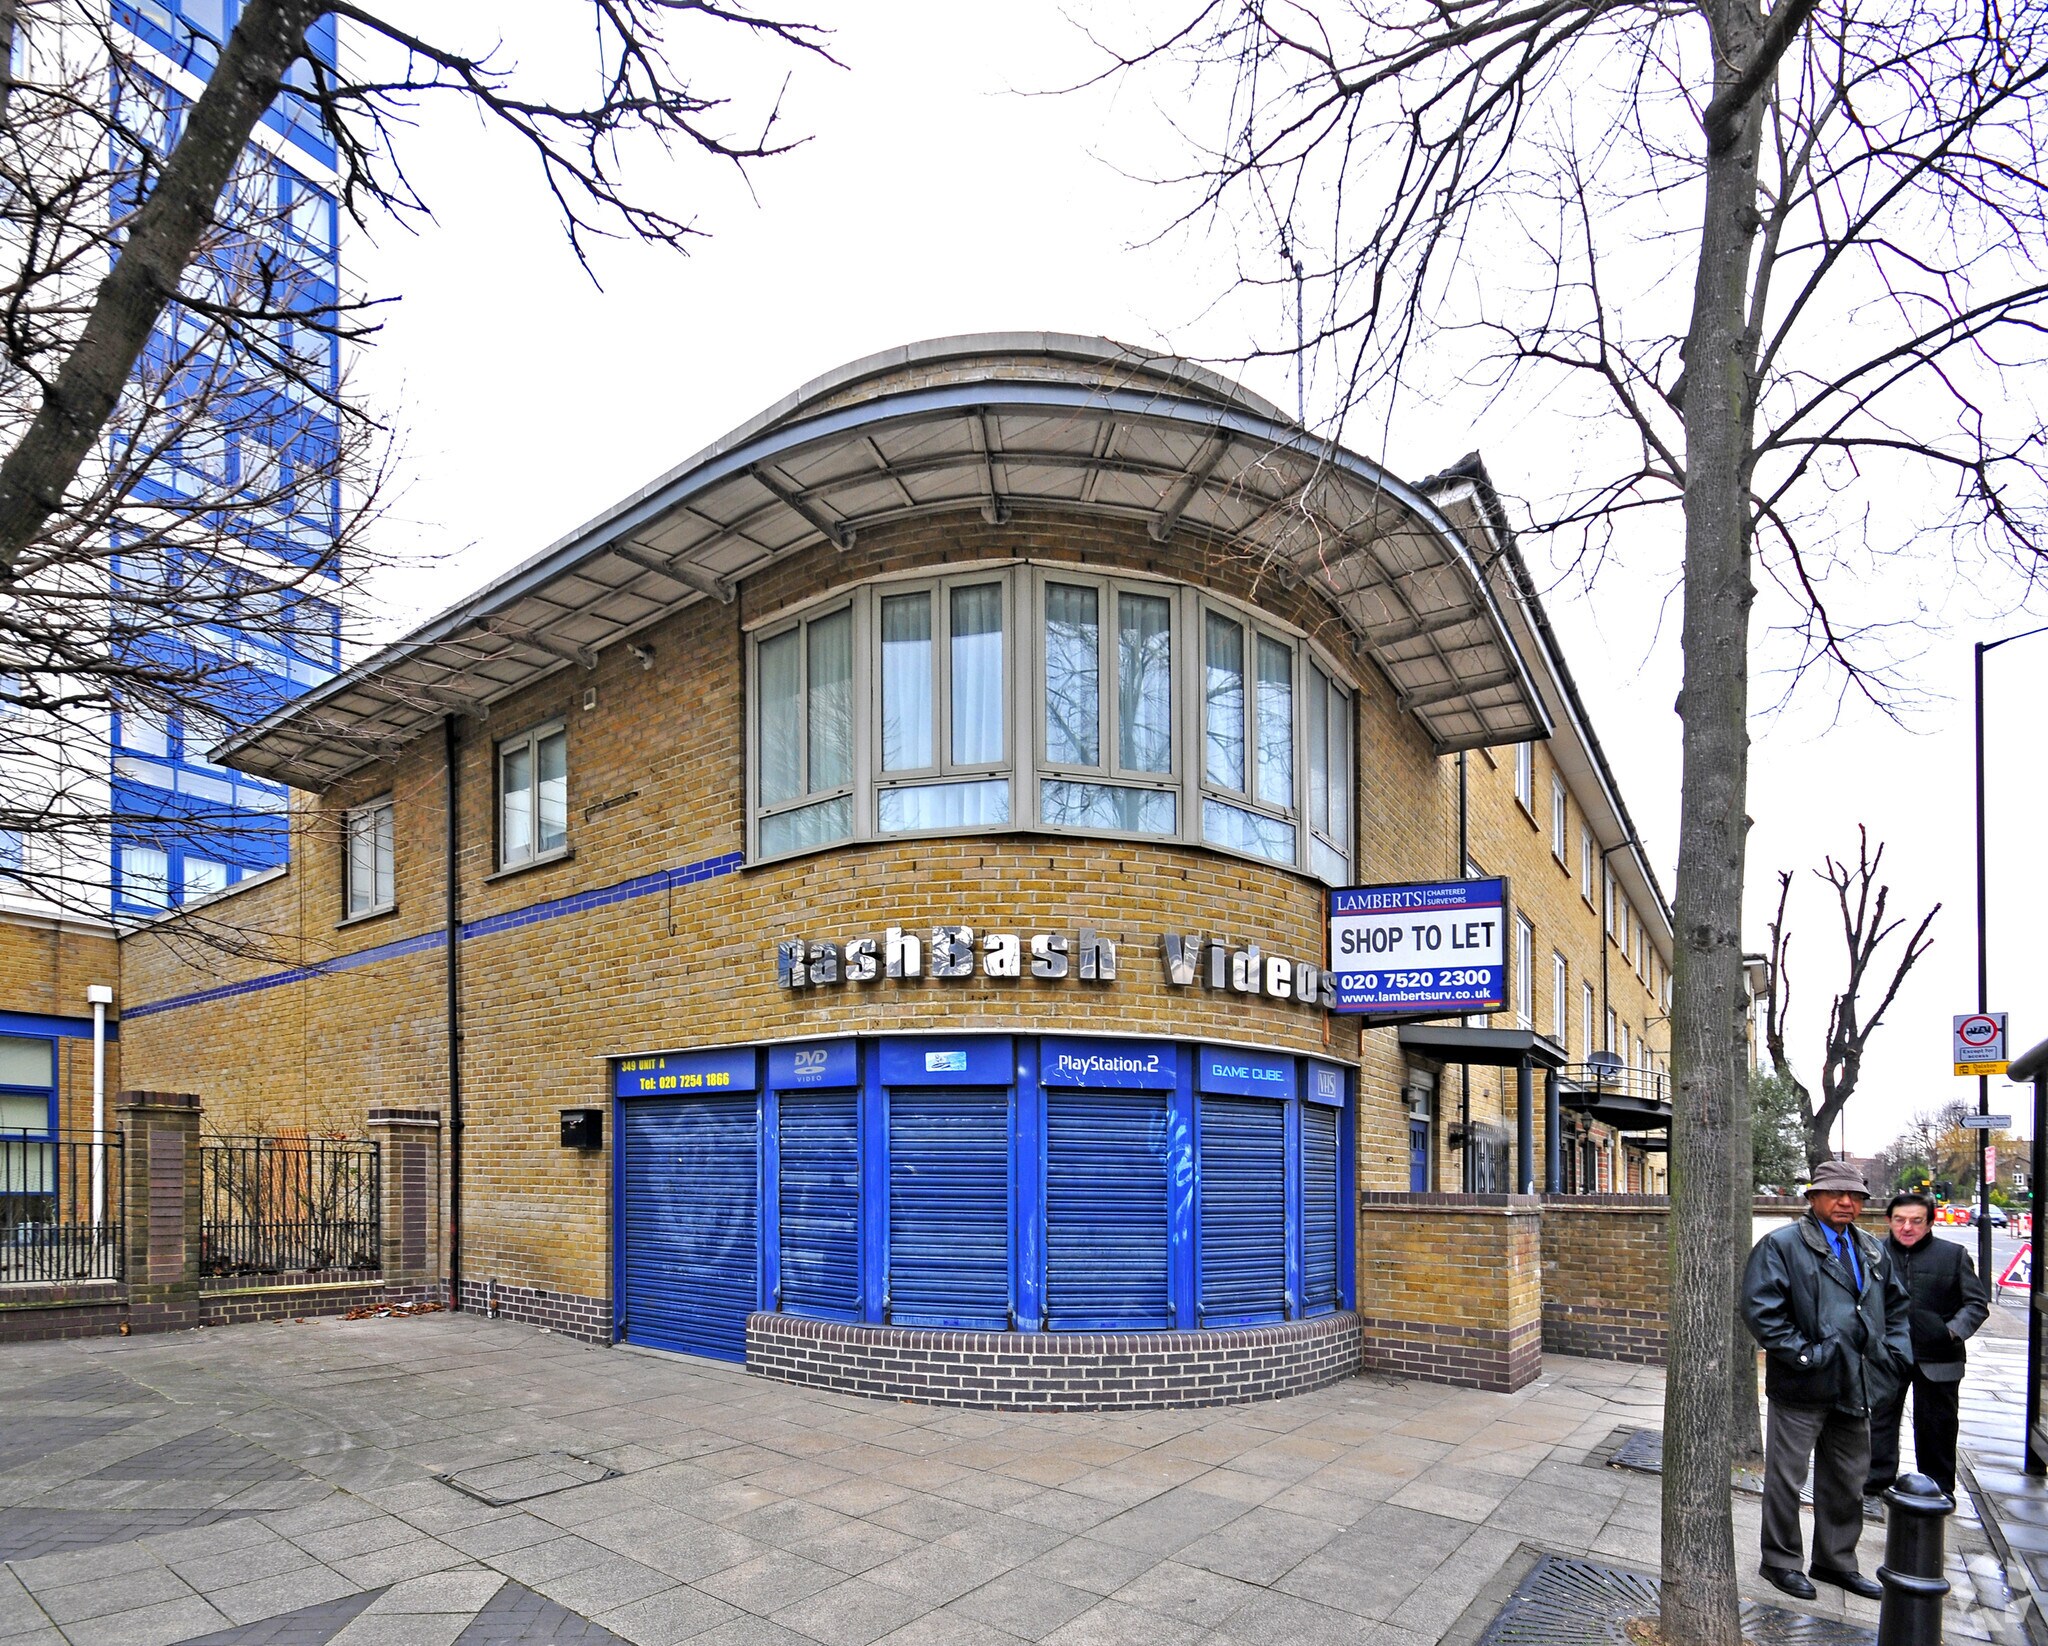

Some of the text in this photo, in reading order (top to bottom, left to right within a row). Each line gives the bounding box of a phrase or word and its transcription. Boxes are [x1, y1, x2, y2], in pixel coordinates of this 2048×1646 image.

[1337, 891, 1423, 911] LAMBERTS
[1427, 888, 1466, 897] CHARTERED
[1427, 896, 1466, 906] SURVEYORS
[1340, 921, 1495, 954] SHOP TO LET
[778, 925, 1337, 1009] RashBash Videos
[1341, 969, 1491, 990] 020 7520 2300
[1342, 988, 1491, 1003] www.lambertsurv.co.uk
[621, 1058, 665, 1072] 349 UNIT A
[794, 1049, 828, 1066] DVD
[640, 1072, 729, 1090] Tel: 020 7254 1866
[1212, 1064, 1284, 1082] GAME CUBE
[1318, 1073, 1335, 1094] VHS
